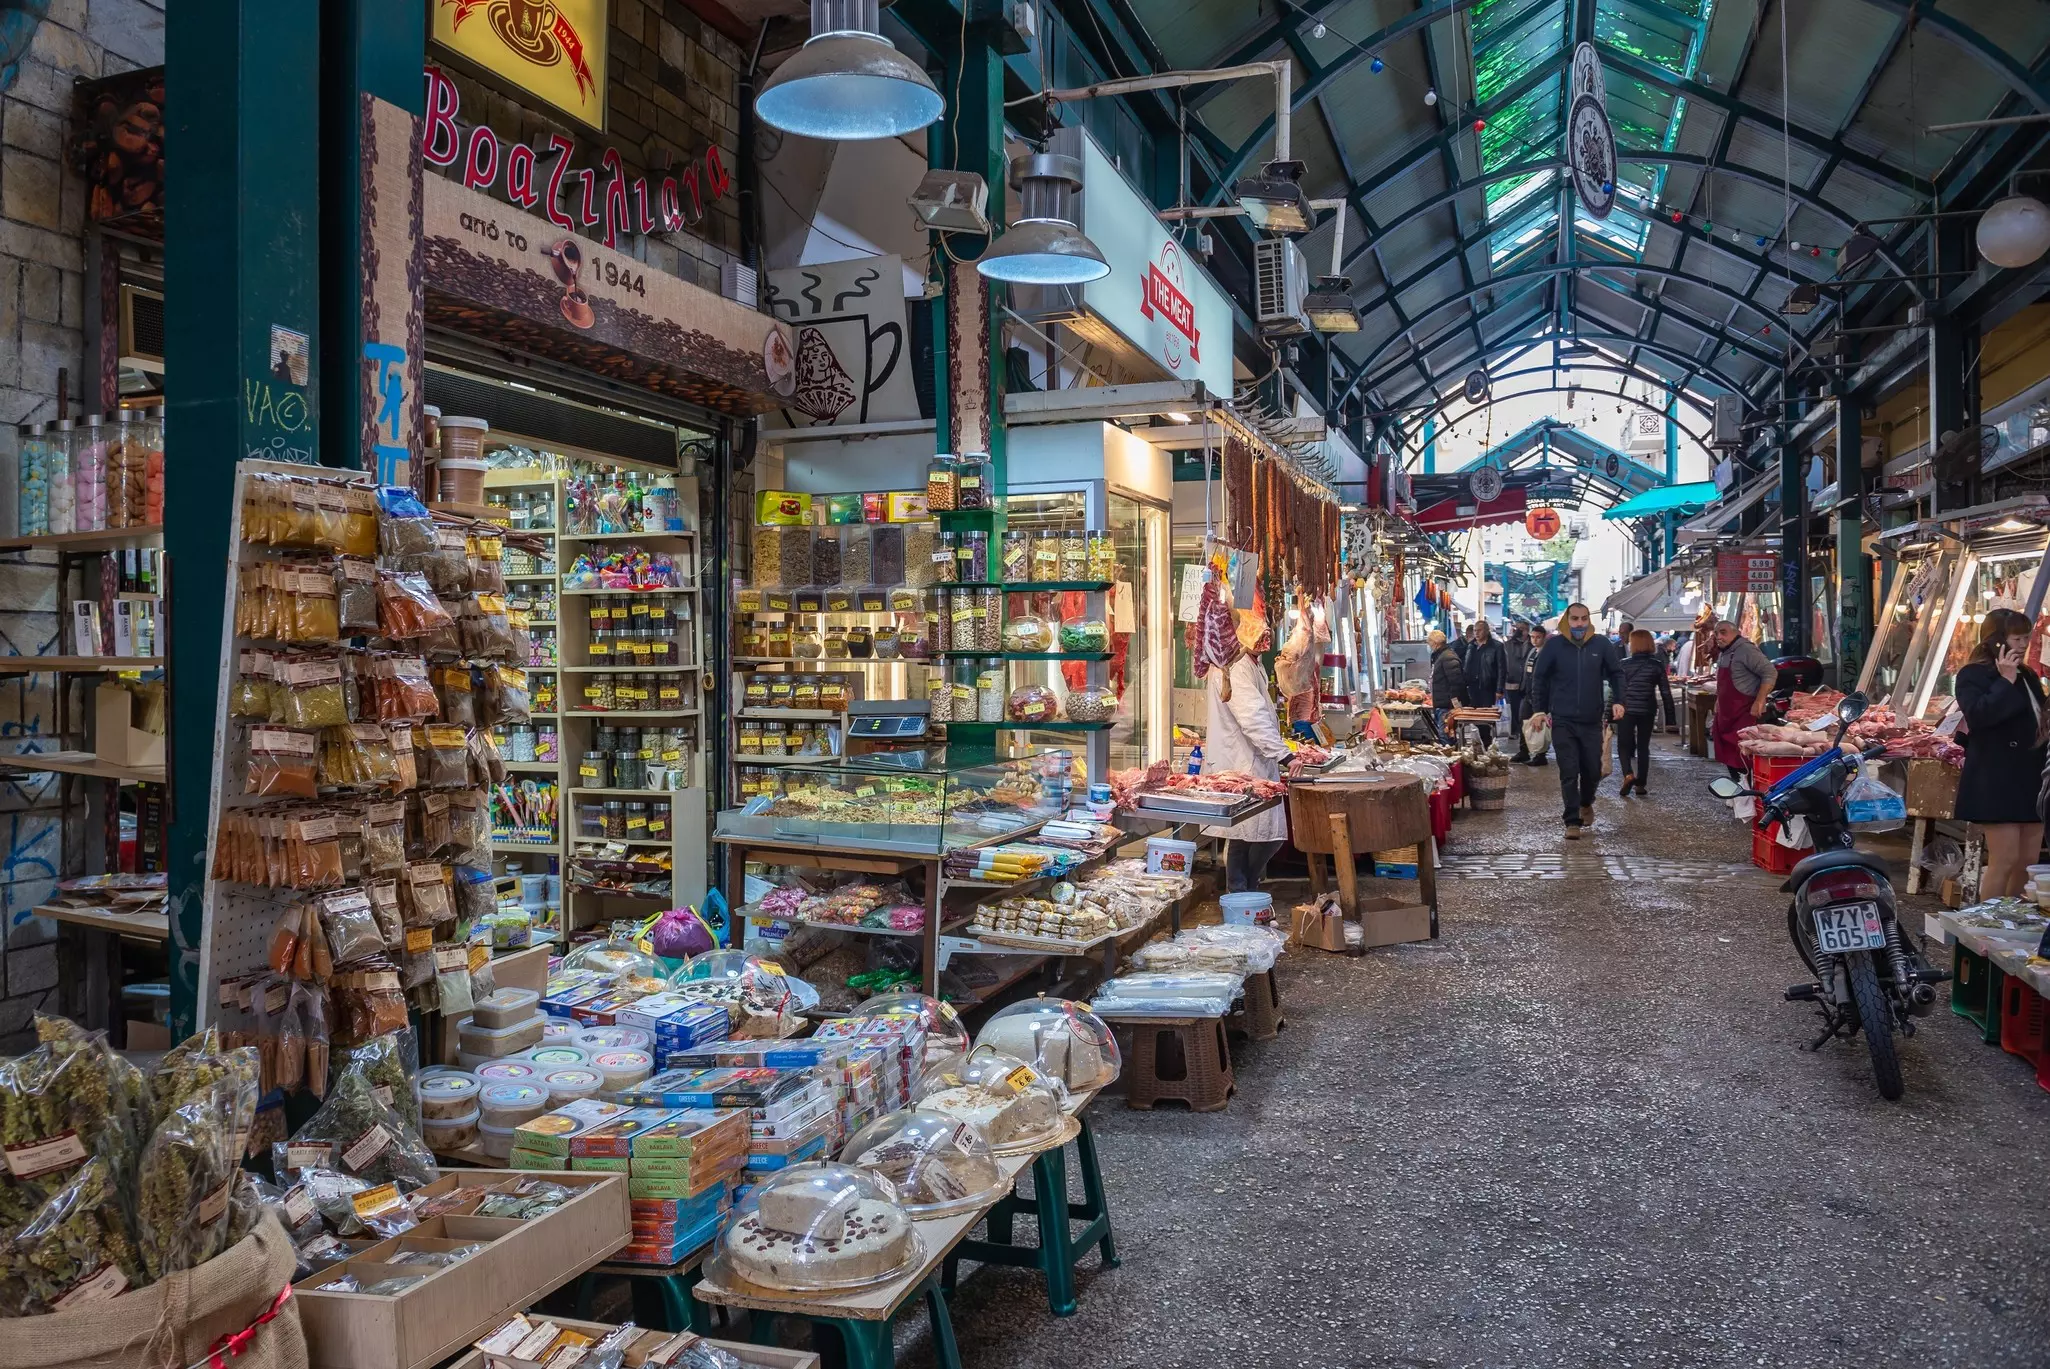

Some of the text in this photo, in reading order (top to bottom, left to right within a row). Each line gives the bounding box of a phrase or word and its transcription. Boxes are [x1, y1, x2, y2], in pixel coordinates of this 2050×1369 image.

[556, 25, 576, 49] 1944
[423, 67, 731, 251] Βραζιλιάνα
[460, 212, 528, 252] από το
[591, 256, 647, 299] 1944
[1153, 273, 1192, 332] THE MEAT
[1819, 907, 1859, 931] NZY
[1824, 928, 1864, 949] 605
[678, 1095, 697, 1103] GREECE
[529, 1138, 553, 1149] KATAIFI
[749, 1156, 768, 1165] GREECE
